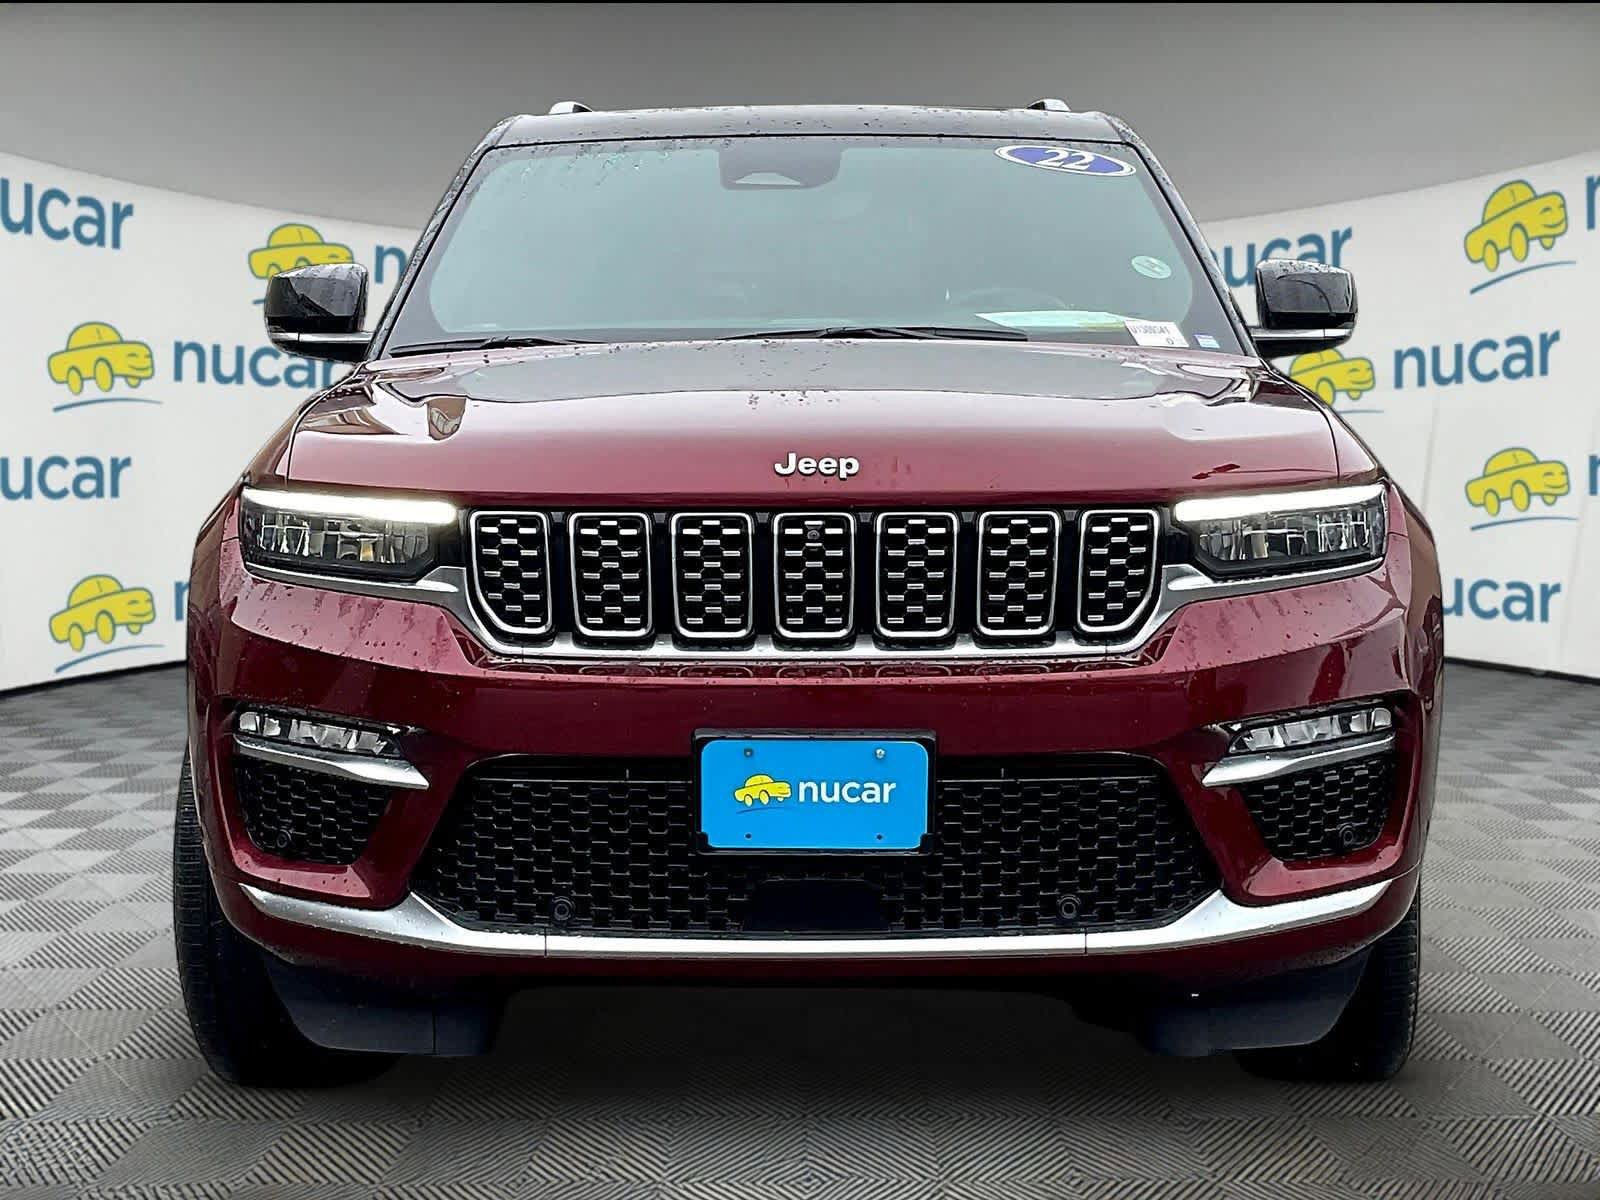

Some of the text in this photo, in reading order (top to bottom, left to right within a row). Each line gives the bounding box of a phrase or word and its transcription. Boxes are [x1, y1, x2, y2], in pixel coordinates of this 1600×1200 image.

[1035, 149, 1096, 171] 22
[1211, 227, 1353, 288] uar
[173, 340, 335, 389] nucar
[1394, 330, 1560, 389] nucar
[774, 452, 860, 480] Jeep
[797, 780, 896, 804] nucar
